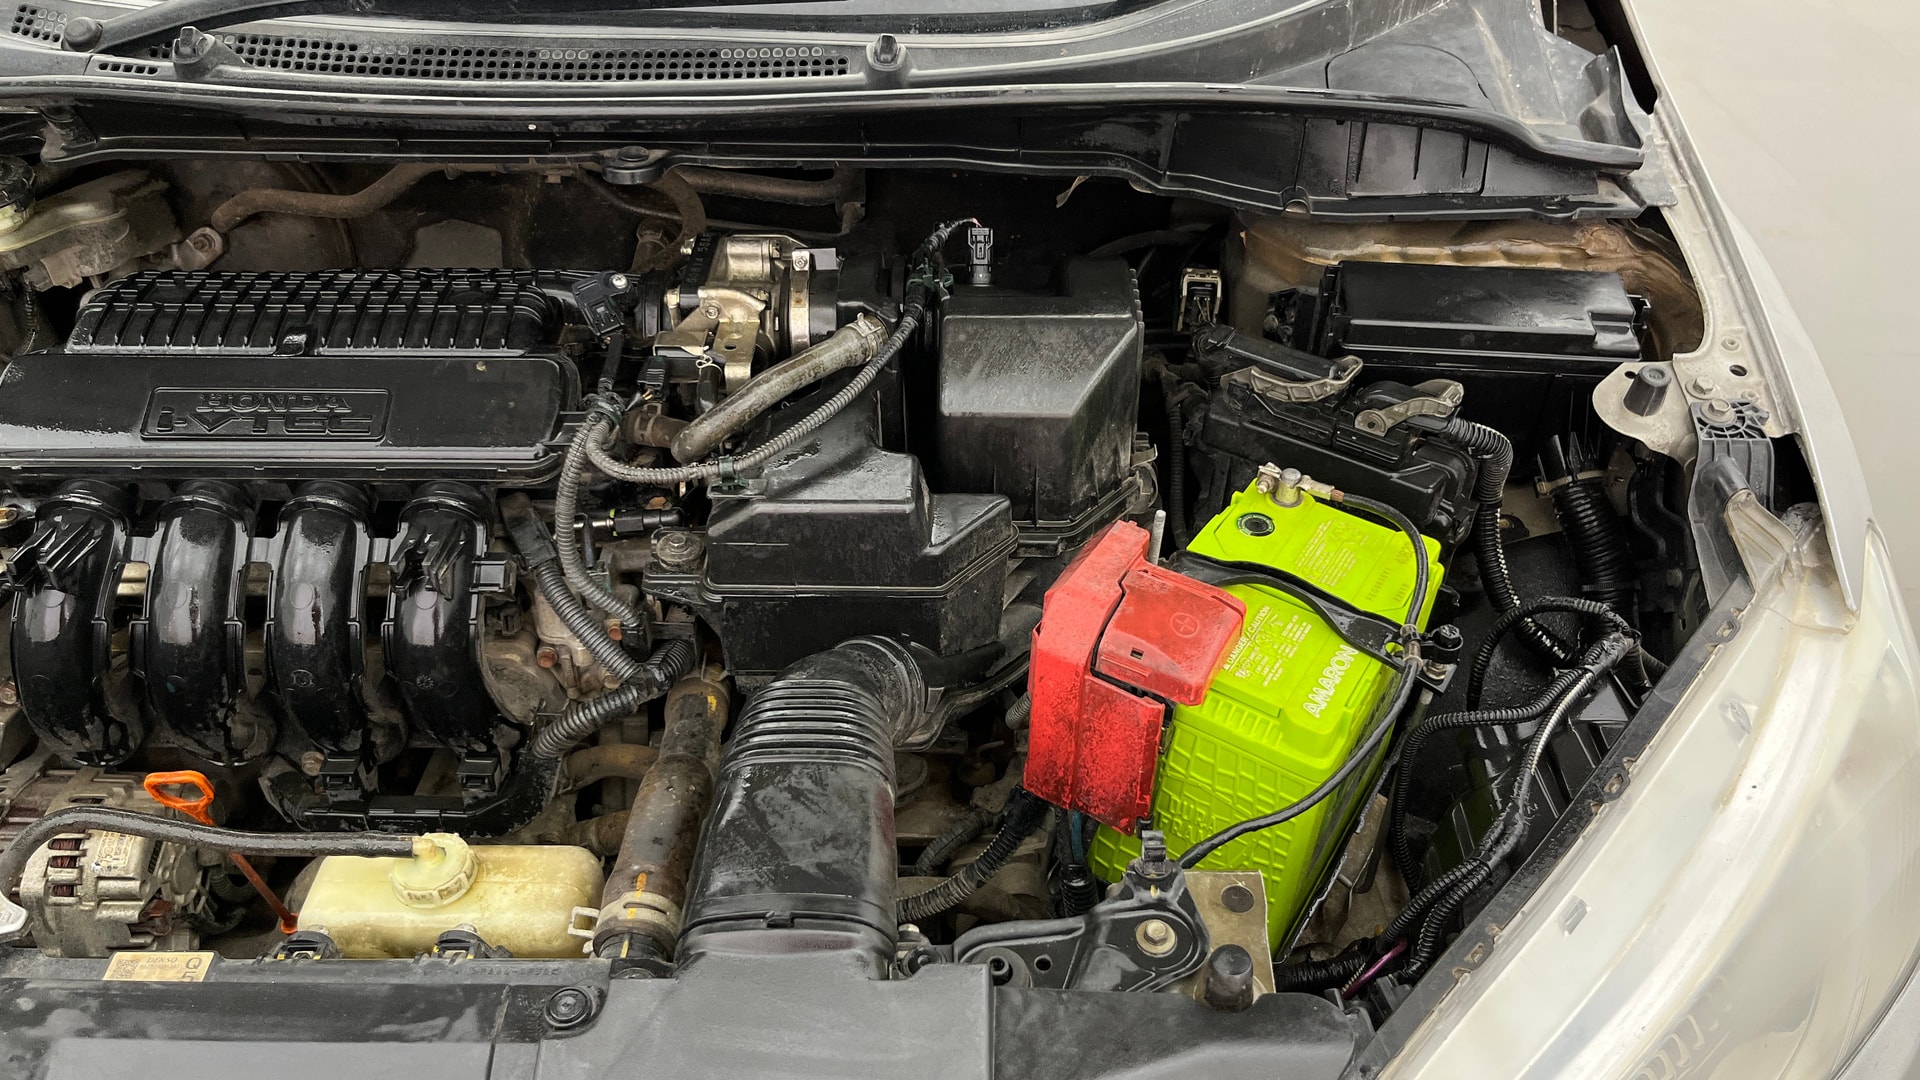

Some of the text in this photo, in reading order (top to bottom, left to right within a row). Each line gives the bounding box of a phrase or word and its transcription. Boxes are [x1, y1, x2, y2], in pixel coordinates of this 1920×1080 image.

[155, 405, 373, 435] i-VTEC
[196, 392, 354, 413] HONDA
[1228, 636, 1249, 665] DANGER
[1247, 605, 1271, 634] CAUTION
[1302, 643, 1360, 719] AMARON
[1168, 793, 1217, 834] DURA
[185, 957, 203, 970] Q
